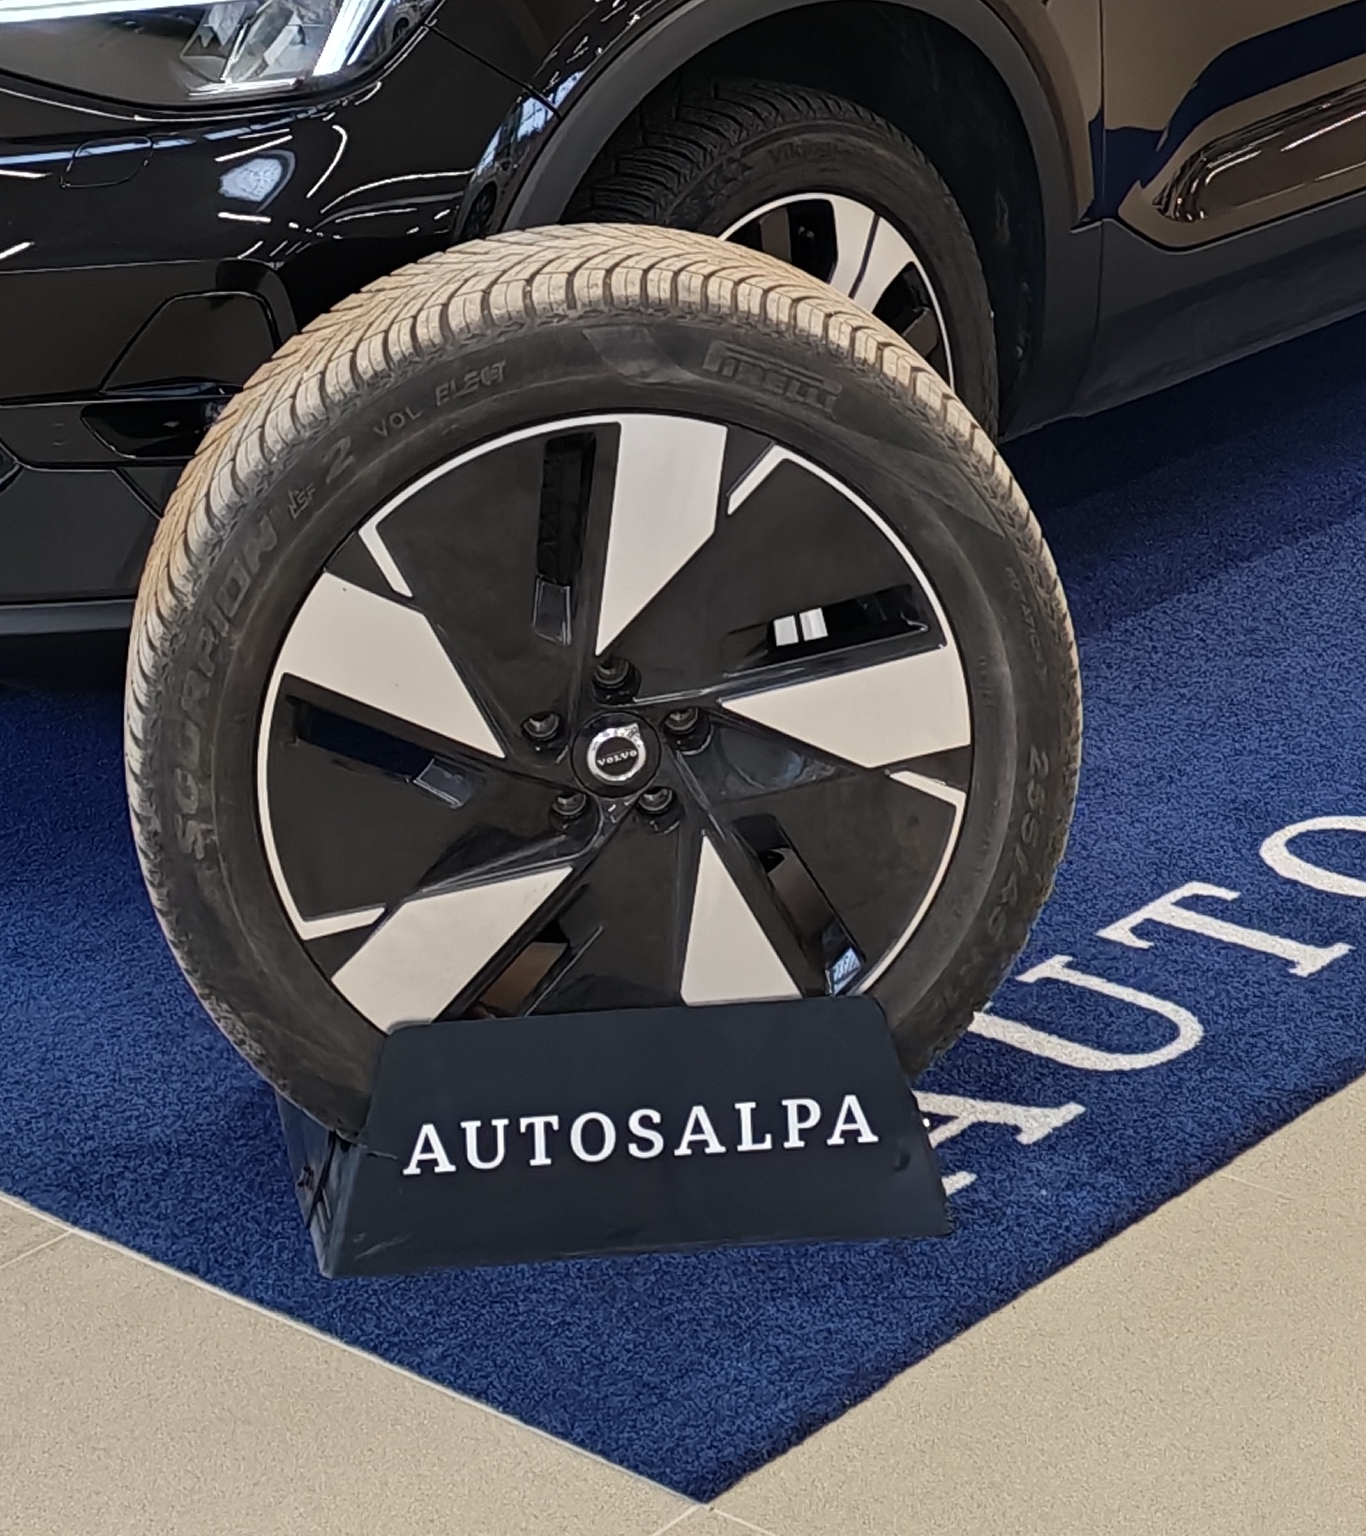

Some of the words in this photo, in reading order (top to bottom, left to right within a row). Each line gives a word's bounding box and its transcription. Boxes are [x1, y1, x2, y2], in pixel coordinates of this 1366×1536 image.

[373, 405, 424, 438] VOL
[596, 749, 638, 767] VOLVO
[402, 1094, 879, 1176] AUTOSALPA
